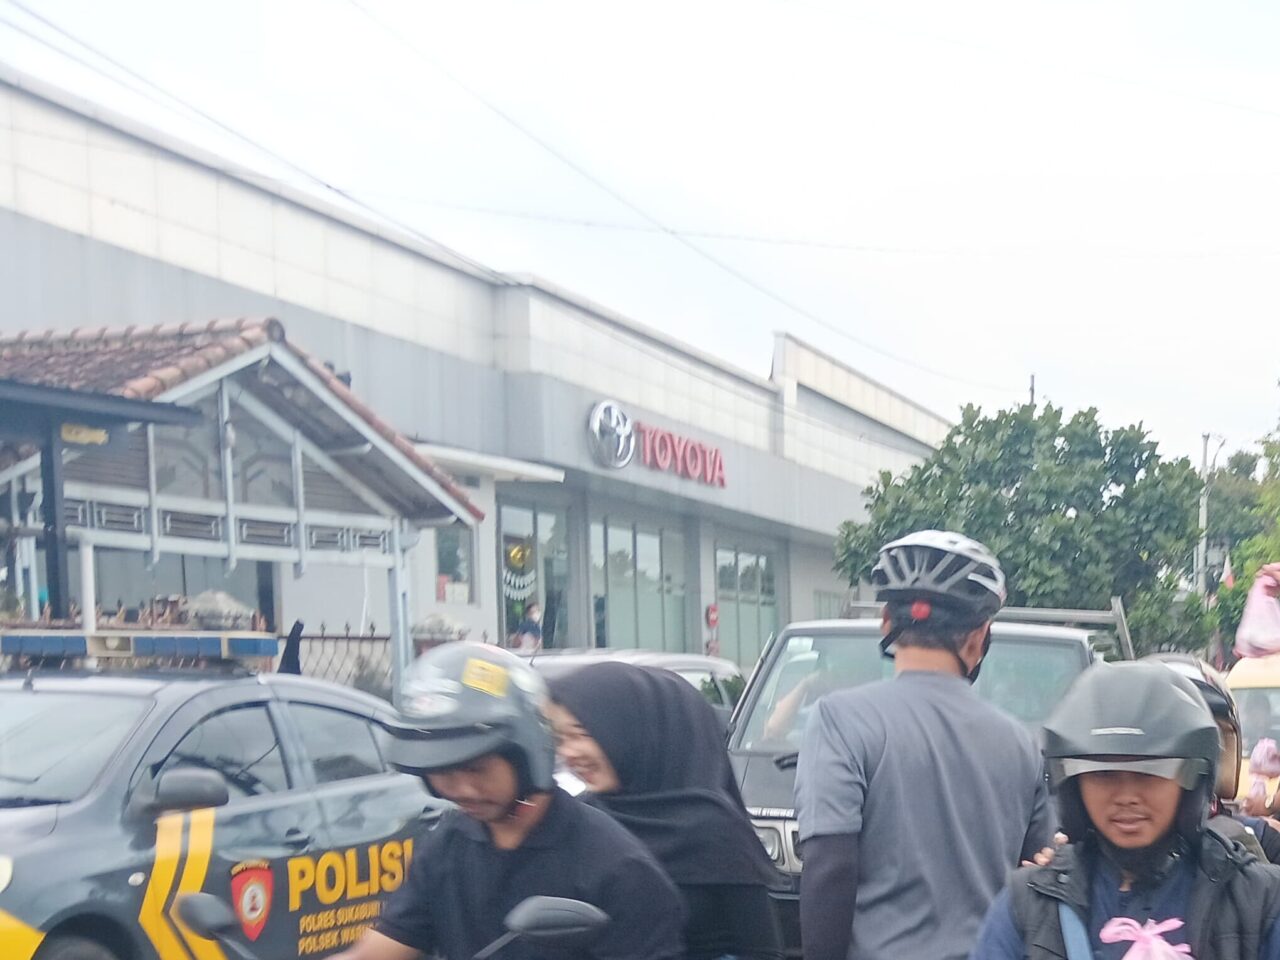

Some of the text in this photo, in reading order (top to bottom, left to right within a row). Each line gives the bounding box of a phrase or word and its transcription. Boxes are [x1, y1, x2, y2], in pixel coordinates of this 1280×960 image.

[635, 421, 726, 489] TOYOTA
[299, 908, 336, 934] POLRES
[298, 929, 340, 956] POLSEK
